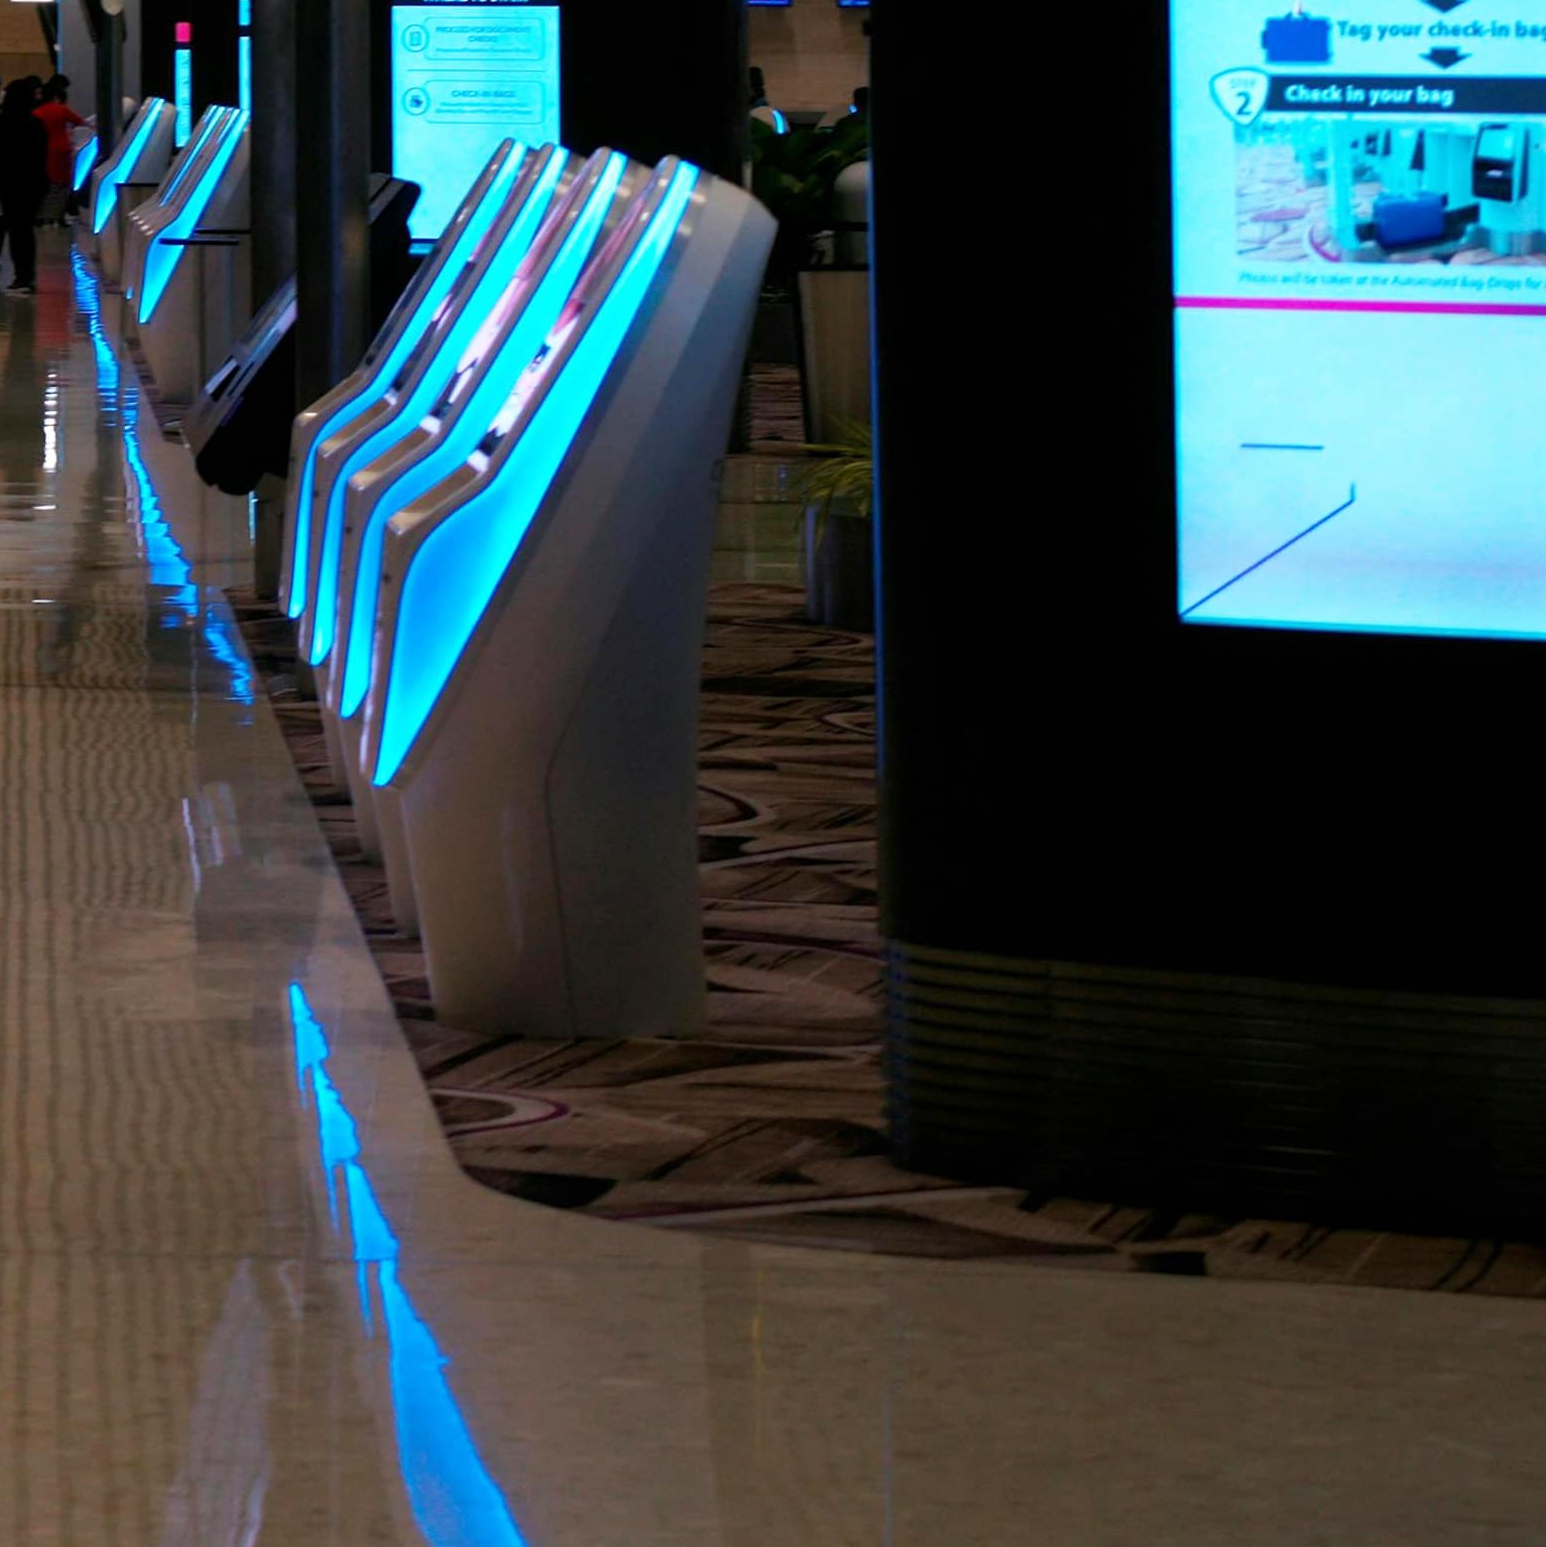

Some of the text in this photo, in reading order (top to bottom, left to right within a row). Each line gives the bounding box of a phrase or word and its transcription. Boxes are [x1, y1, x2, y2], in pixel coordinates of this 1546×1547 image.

[1337, 20, 1372, 41] Tag
[1377, 23, 1423, 41] your
[1428, 19, 1510, 38] check-in
[1235, 92, 1251, 116] 2
[1285, 84, 1342, 103] Check
[1369, 88, 1413, 107] your
[1416, 85, 1455, 107] bag
